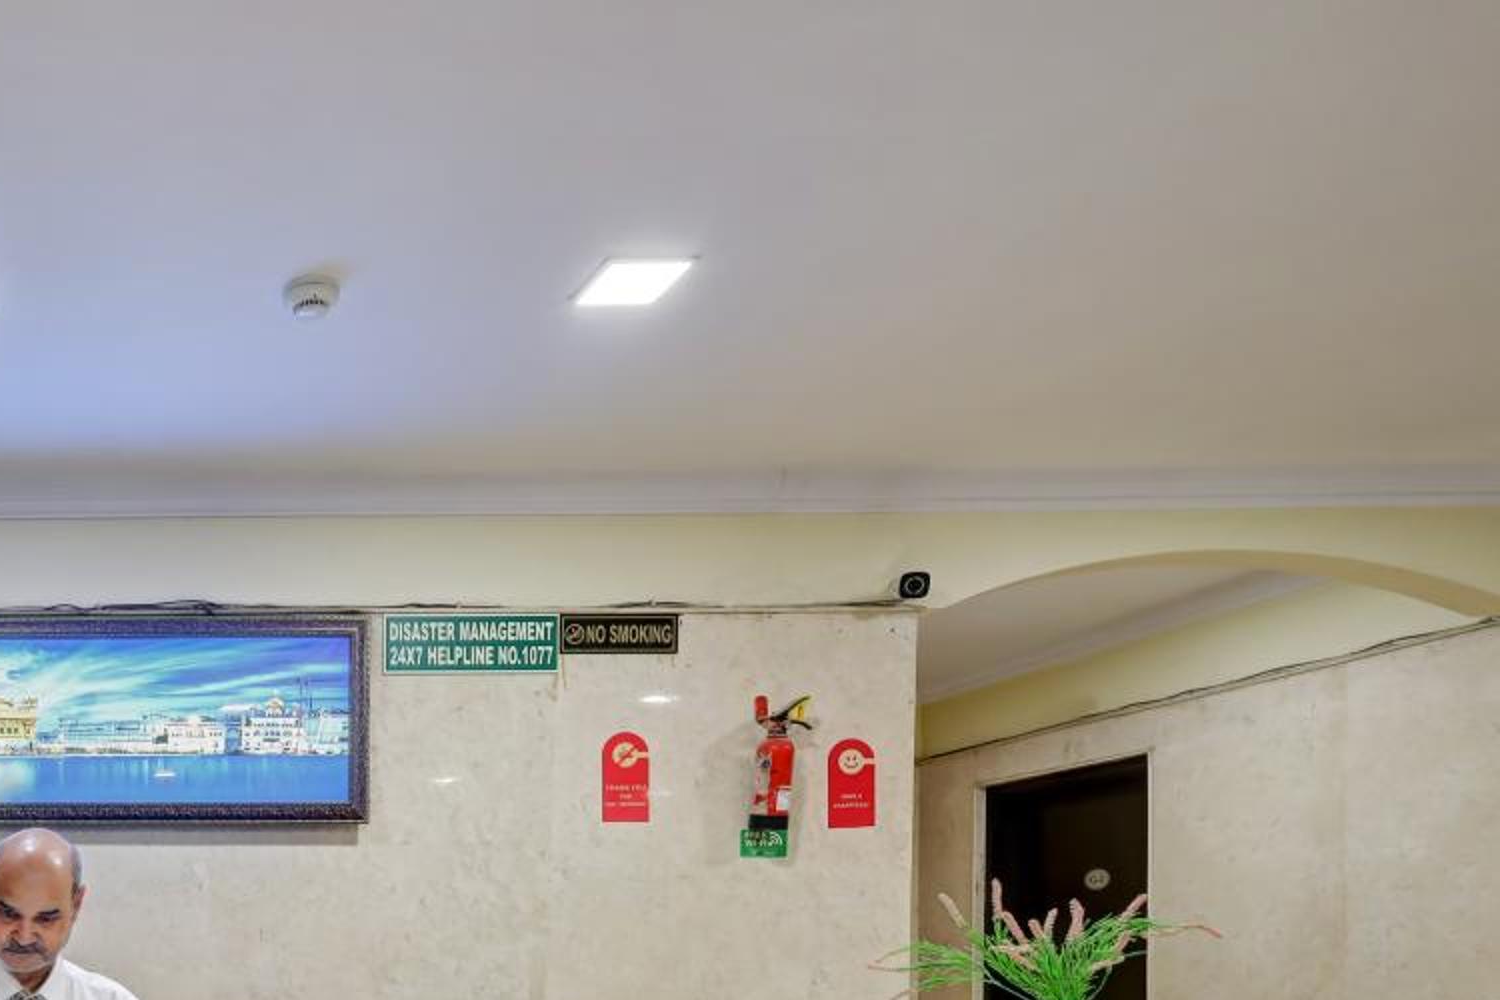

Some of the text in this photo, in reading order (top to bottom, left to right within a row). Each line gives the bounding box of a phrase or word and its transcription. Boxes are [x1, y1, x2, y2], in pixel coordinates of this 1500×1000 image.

[389, 621, 555, 641] DISASTER MANAGEMENT
[585, 624, 673, 643] NO SMOKING
[389, 647, 423, 664] 24X7
[427, 646, 495, 665] HELPLINE
